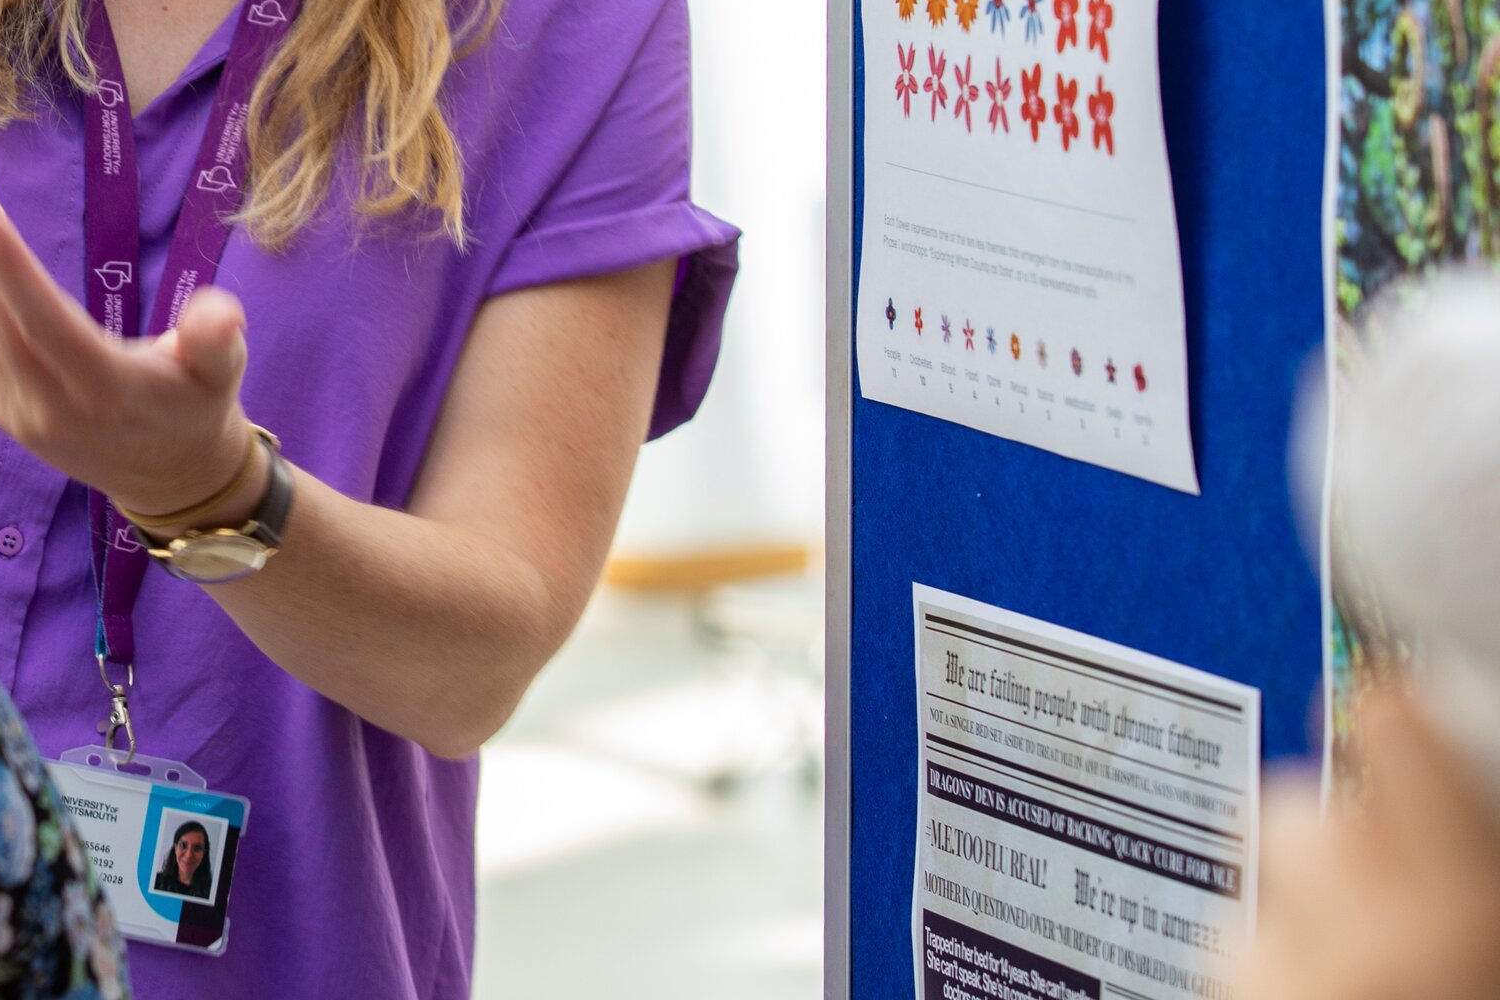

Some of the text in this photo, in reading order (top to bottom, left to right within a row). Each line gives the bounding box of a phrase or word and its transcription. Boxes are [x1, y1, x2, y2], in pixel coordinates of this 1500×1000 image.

[101, 108, 113, 175] PORTSMOUTH
[110, 109, 121, 167] UNIVERSITY
[214, 108, 238, 163] UNIVERSITY
[224, 103, 249, 165] PORTSMOUTH
[166, 277, 190, 331] NIVERSITY
[929, 706, 944, 724] NOT
[949, 713, 975, 736] SINGLE
[975, 721, 989, 740] BED
[990, 725, 1003, 744] SET
[1004, 729, 1024, 751] ASIDE
[945, 649, 1222, 770] We are failing people with chronic fatigue
[929, 768, 975, 800] DRAGONS'
[974, 784, 996, 809] DEN
[996, 789, 1006, 812] IS
[1007, 796, 1052, 829] ACCUSED
[1051, 810, 1067, 835] OF
[1066, 814, 1113, 850] BACKING
[1153, 846, 1185, 877] CURE
[1185, 855, 1210, 884] FOR
[954, 828, 984, 865] TOO
[984, 839, 1010, 875] FLU
[1009, 848, 1048, 889] REAL!
[923, 870, 962, 911] MOTHER
[961, 885, 971, 909] IS
[970, 889, 1030, 931] QUESTIONED
[1029, 912, 1057, 942] OVER
[1101, 938, 1117, 965] OF
[1116, 944, 1168, 984] DISABLED
[1118, 894, 1139, 934] up
[1142, 896, 1159, 933] in
[925, 926, 954, 956] Trapped
[953, 937, 961, 958] in
[961, 940, 974, 963] her
[973, 945, 989, 970] bed
[988, 952, 1001, 974] for
[1030, 968, 1046, 994] She
[926, 948, 941, 973] She
[940, 959, 959, 981] can't
[959, 966, 983, 991] speak.
[982, 971, 1003, 999] She's
[1002, 980, 1011, 1000] in
